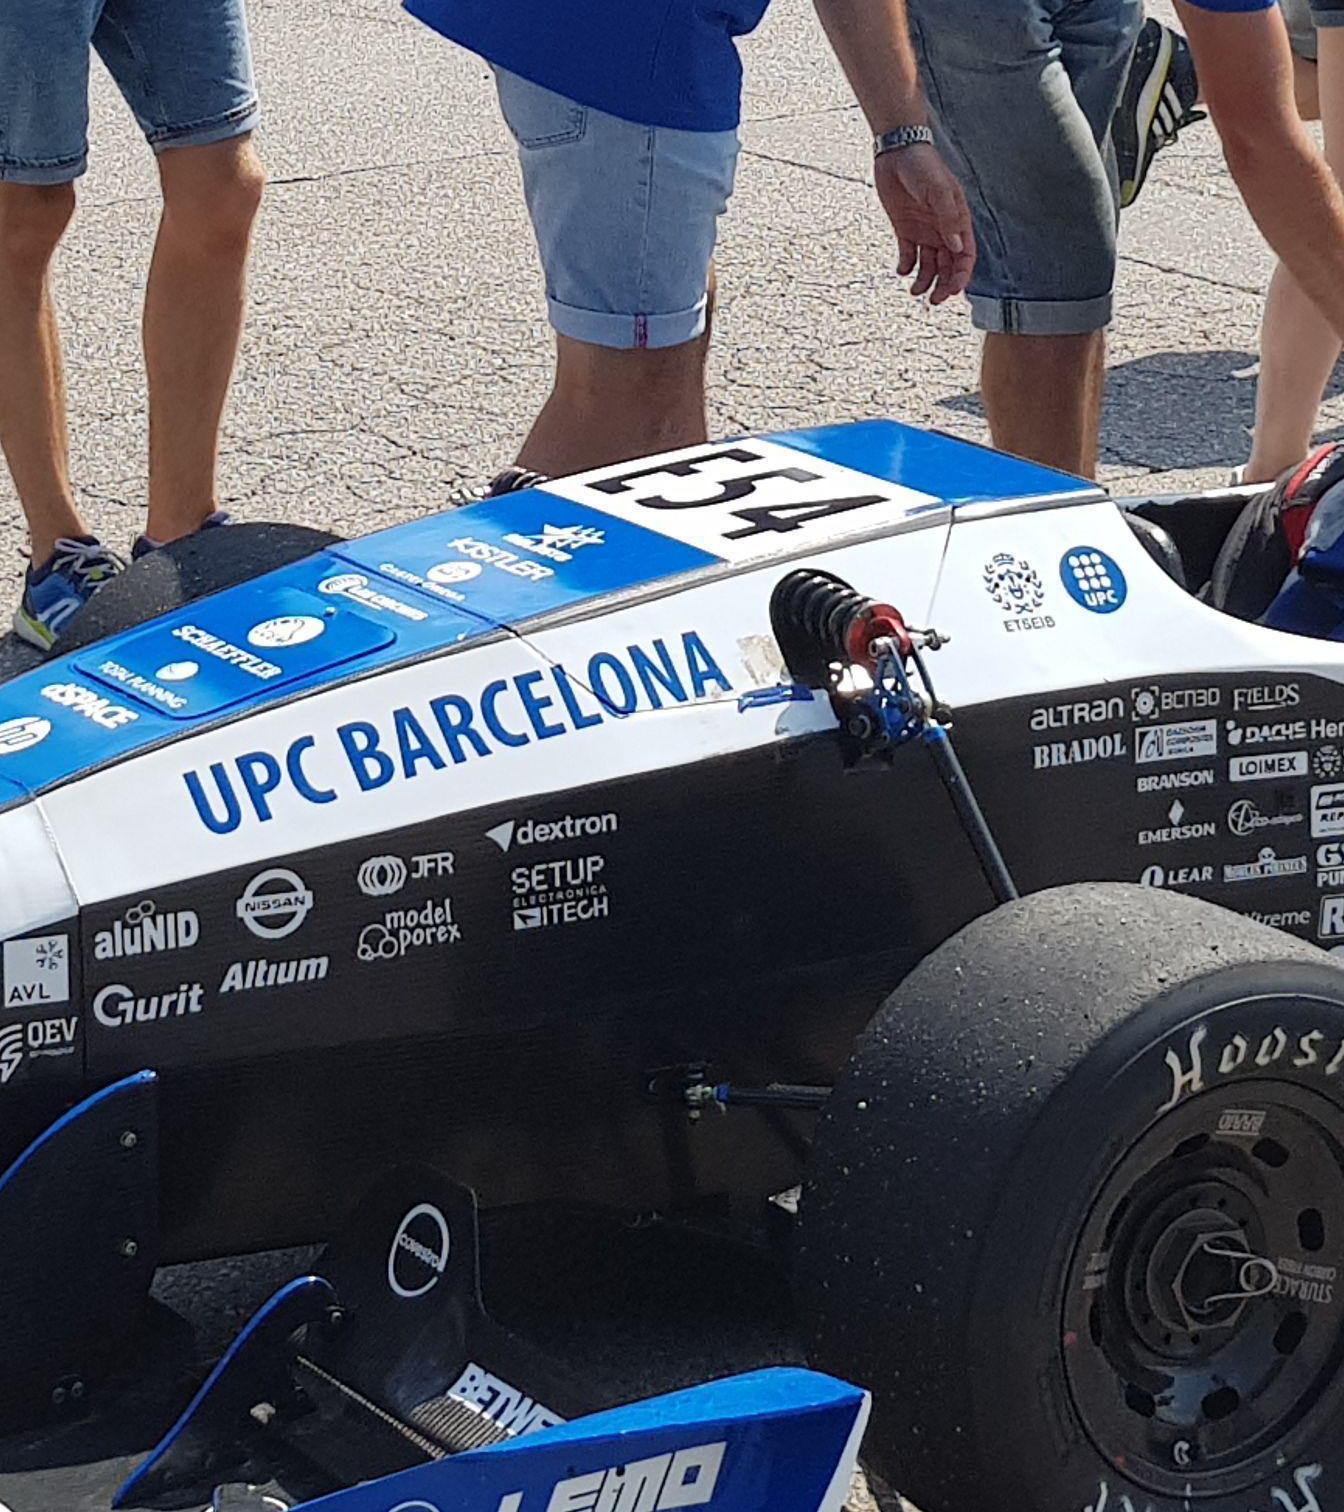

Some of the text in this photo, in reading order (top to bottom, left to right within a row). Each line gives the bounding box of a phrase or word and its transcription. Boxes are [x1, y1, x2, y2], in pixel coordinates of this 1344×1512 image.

[584, 448, 891, 540] E54
[1084, 589, 1119, 607] UPC
[171, 625, 283, 680] SCHAEFFLER
[183, 630, 734, 835] UPC BARCELONA
[1033, 732, 1127, 770] BRADOL
[1239, 756, 1296, 777] LOIMEX
[1137, 769, 1214, 793] BRANSON
[516, 813, 618, 846] dextron
[1138, 822, 1216, 845] EMERSON
[410, 851, 455, 879] JFR
[511, 855, 605, 895] SETUP
[1167, 866, 1214, 886] LEAR
[245, 894, 306, 913] NISSAN
[513, 884, 608, 908] ELECTRONICA
[385, 897, 453, 930] model
[94, 909, 200, 961] aluNID
[400, 922, 462, 956] porex
[219, 955, 330, 994] Altium
[8, 982, 52, 1004] AVL
[93, 983, 204, 1027] Gurit
[27, 1016, 79, 1049] QEV
